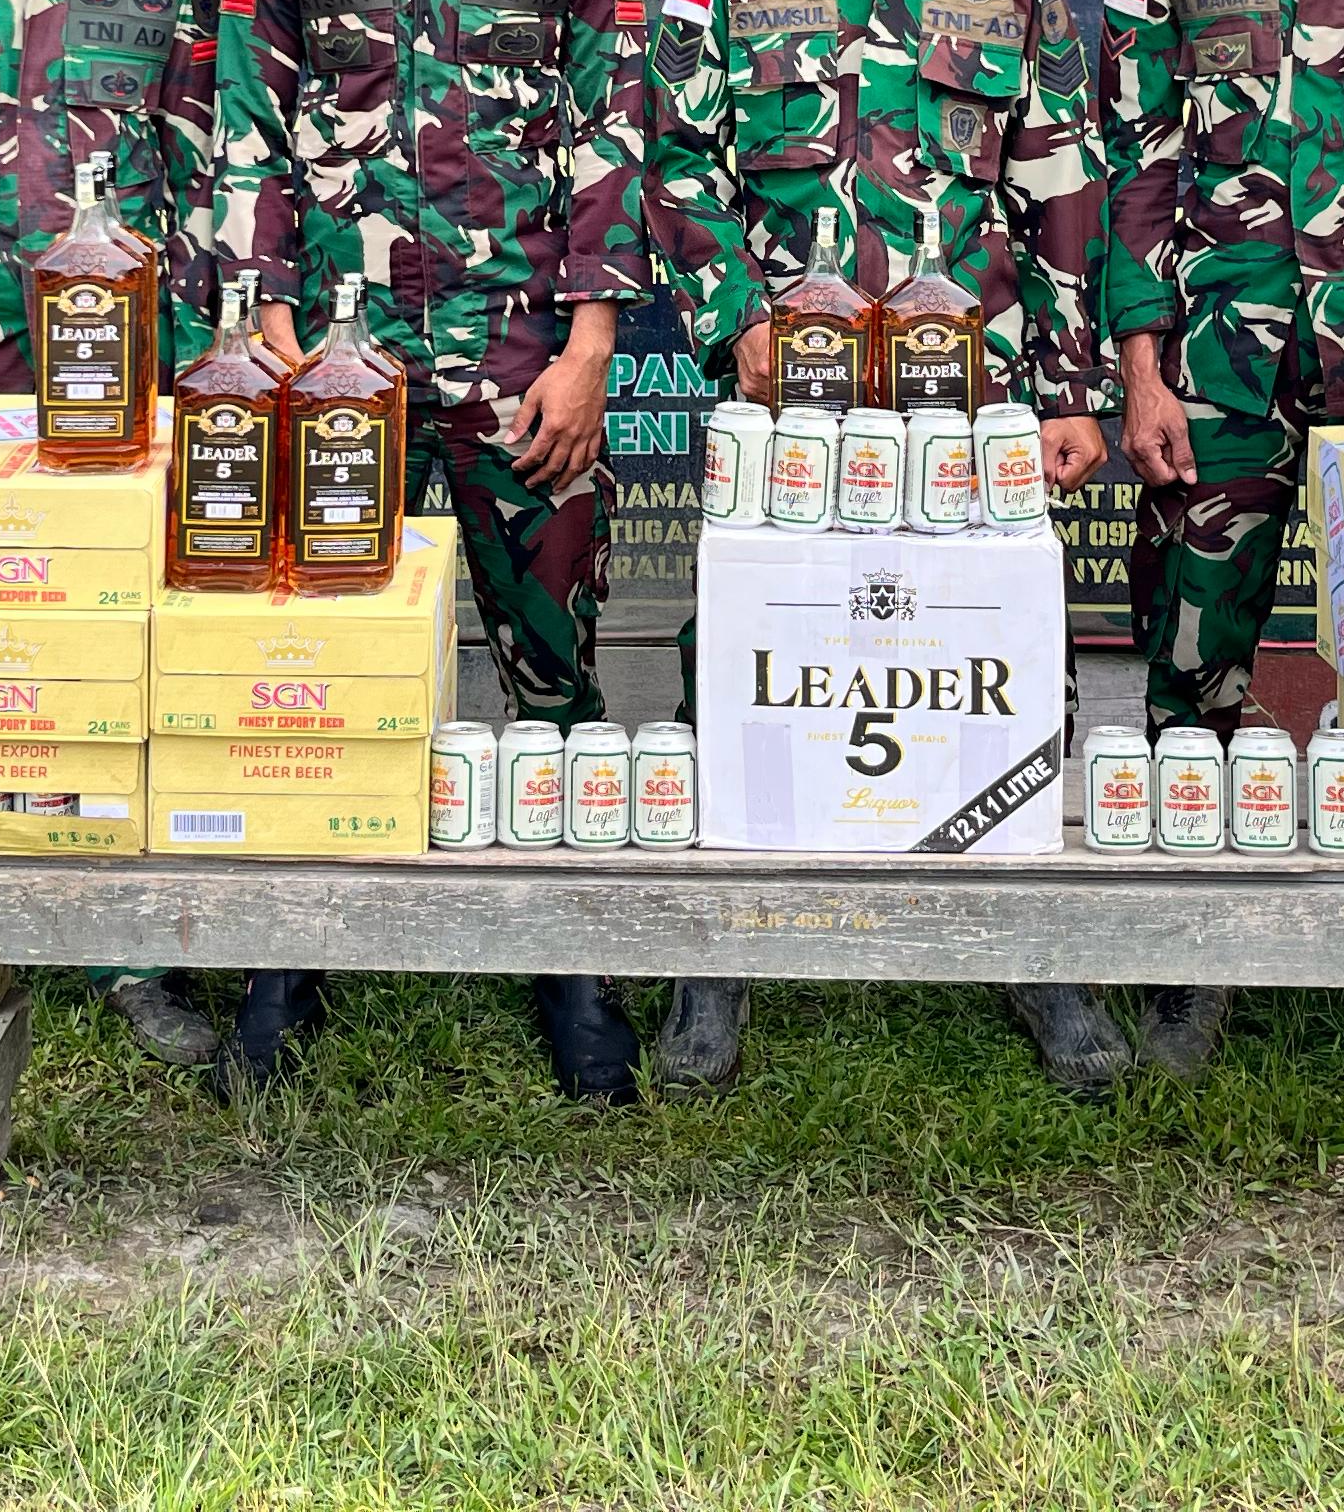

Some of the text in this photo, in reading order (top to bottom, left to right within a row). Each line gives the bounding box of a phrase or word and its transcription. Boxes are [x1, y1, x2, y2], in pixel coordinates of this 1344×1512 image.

[735, 5, 833, 31] SYAMSUL
[78, 20, 167, 48] TNI AD
[51, 324, 121, 342] LEADER
[75, 342, 93, 360] 5
[786, 364, 849, 381] LEADER
[900, 362, 964, 379] LEADER
[809, 381, 824, 397] 5
[924, 379, 939, 395] 5
[191, 443, 259, 462] LEADER
[308, 448, 377, 466] LEADER
[215, 462, 232, 479] 5
[333, 466, 350, 483] 5
[777, 460, 814, 478] SGN
[847, 460, 888, 478] SGN
[997, 459, 1038, 477] SGN
[98, 591, 119, 605] 24
[751, 648, 1017, 716] LEADER
[250, 681, 333, 711] SGN
[87, 720, 109, 735] 24
[376, 716, 398, 731] 24
[0, 744, 60, 759] EXPORT
[229, 744, 345, 760] FINEST EXPORT
[845, 711, 905, 777] 5
[9, 765, 48, 779] BEER
[242, 765, 333, 779] LAGER BEER
[582, 779, 624, 796] SGN
[644, 779, 687, 796] SGN
[1103, 782, 1145, 800] SGN
[1168, 784, 1212, 801] SGN
[1241, 784, 1284, 801] SGN
[948, 756, 1054, 844] 12 X 1 LITRE
